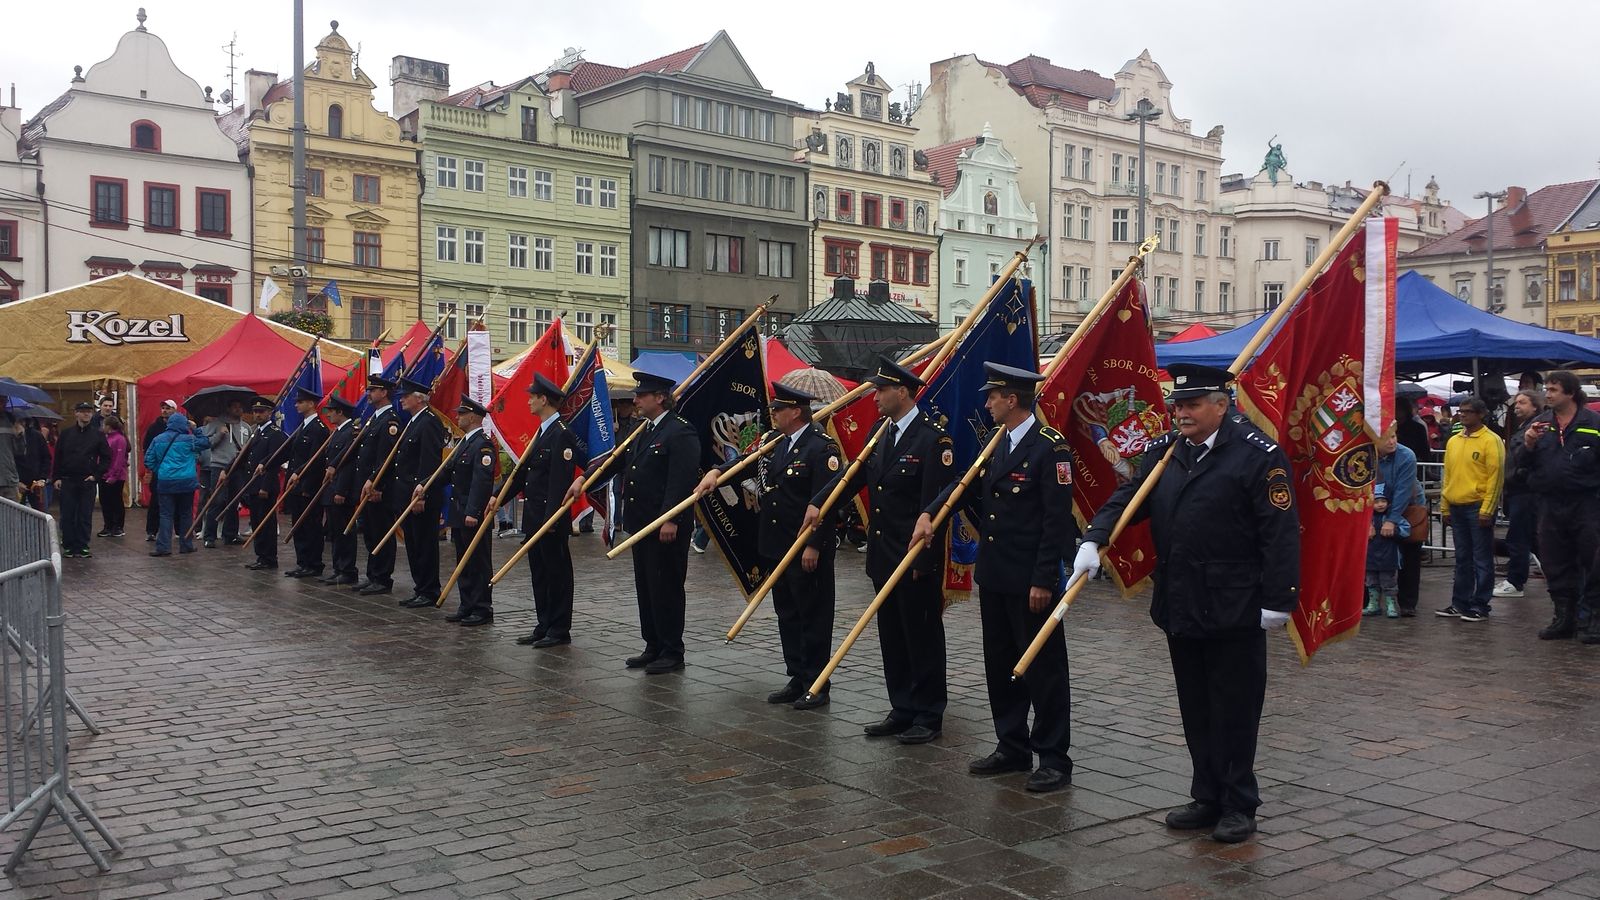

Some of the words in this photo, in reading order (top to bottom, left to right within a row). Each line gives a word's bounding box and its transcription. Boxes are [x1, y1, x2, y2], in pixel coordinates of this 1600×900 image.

[66, 310, 190, 346] Kozel
[663, 305, 671, 339] KOLA
[1103, 359, 1134, 371] SBOR
[730, 381, 757, 398] SBOR
[1072, 447, 1099, 487] TACHOV
[708, 492, 738, 537] KOTEROV
